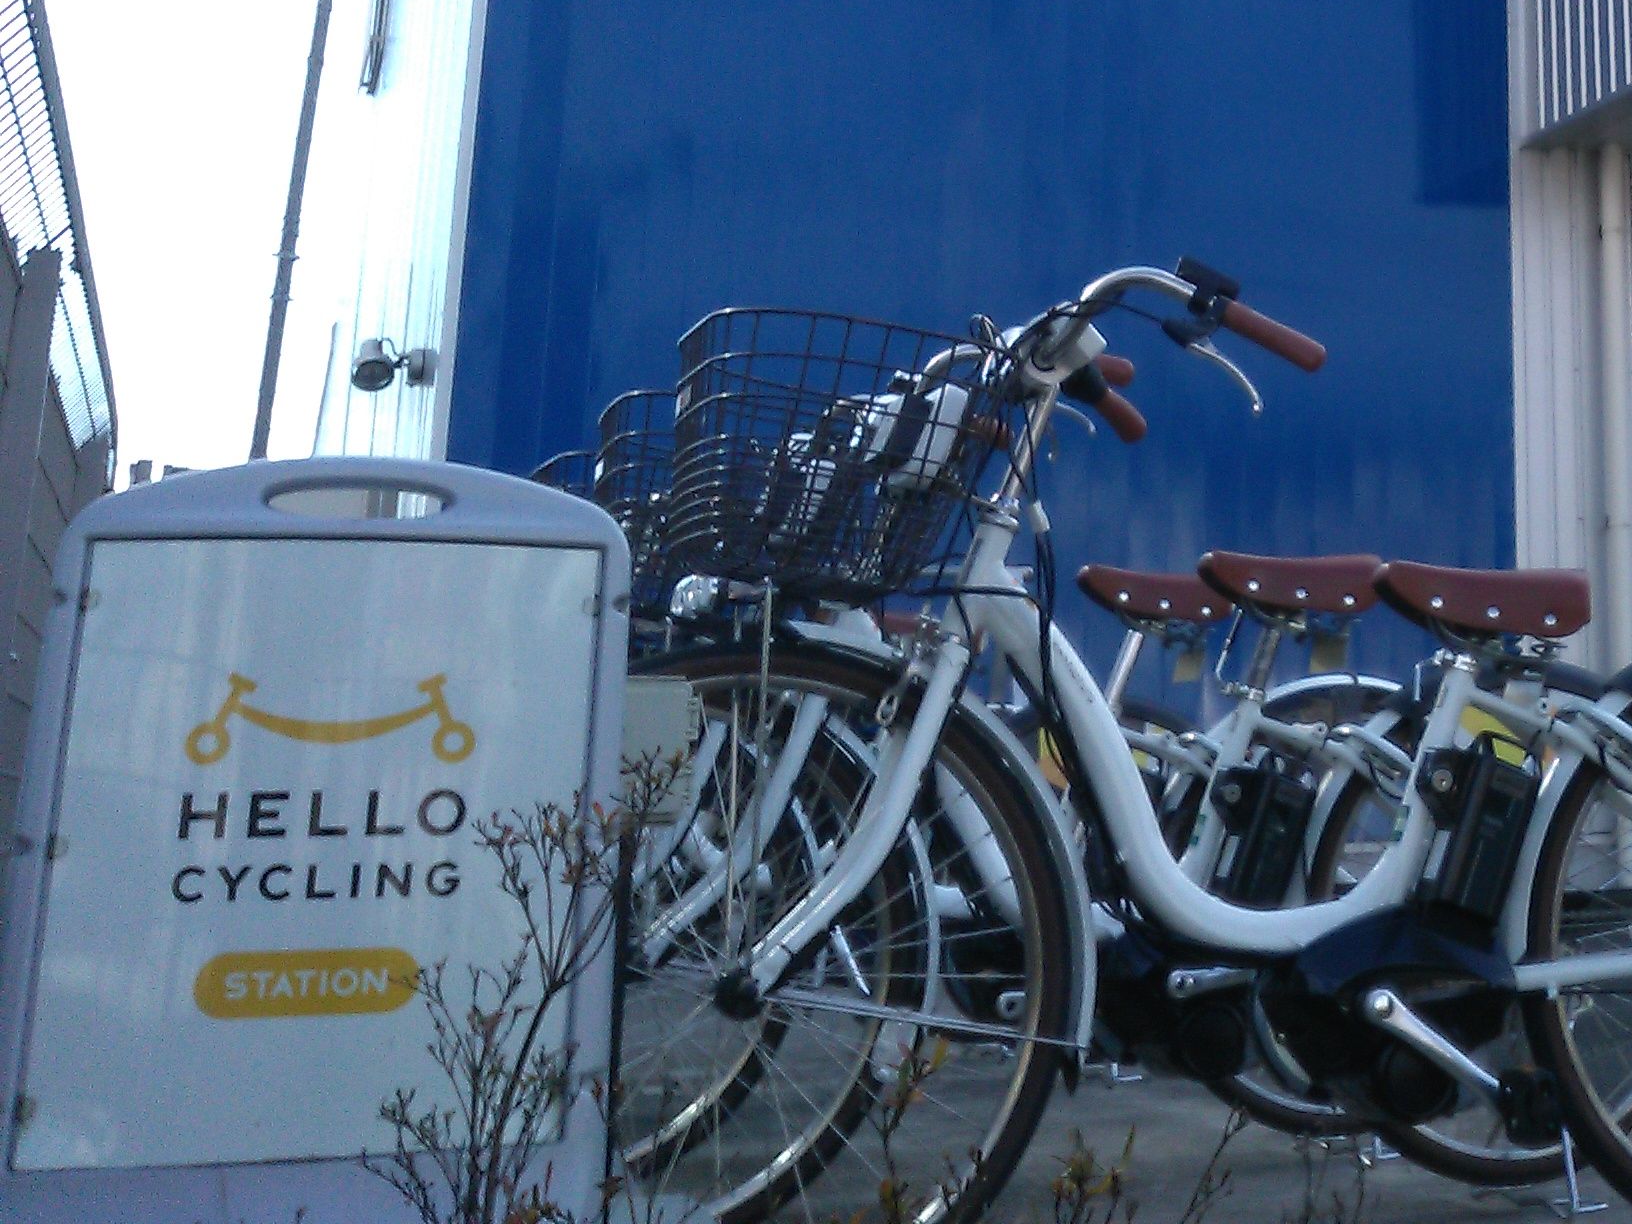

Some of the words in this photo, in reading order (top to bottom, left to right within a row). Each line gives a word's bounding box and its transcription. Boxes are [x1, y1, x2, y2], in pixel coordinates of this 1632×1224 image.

[178, 788, 466, 840] HELLO
[171, 861, 461, 902] CYCLING
[224, 968, 389, 1000] STATION
